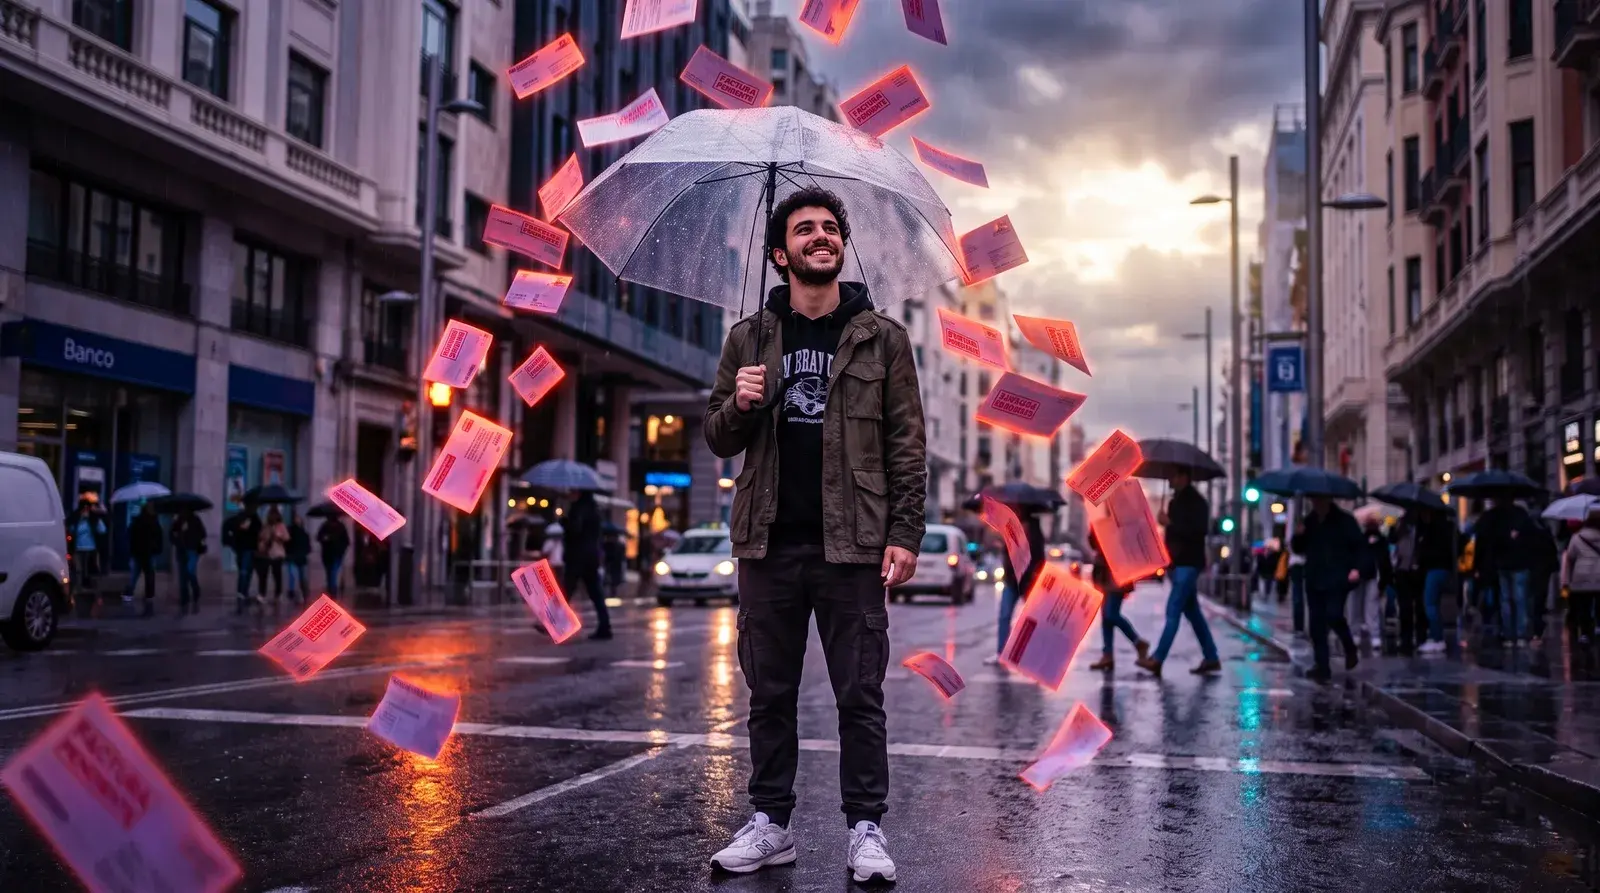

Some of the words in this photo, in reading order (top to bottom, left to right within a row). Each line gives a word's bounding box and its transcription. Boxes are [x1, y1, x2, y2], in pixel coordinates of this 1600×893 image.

[719, 75, 756, 96] FACTURA
[852, 93, 883, 117] FACTURA
[64, 337, 115, 368] Banco
